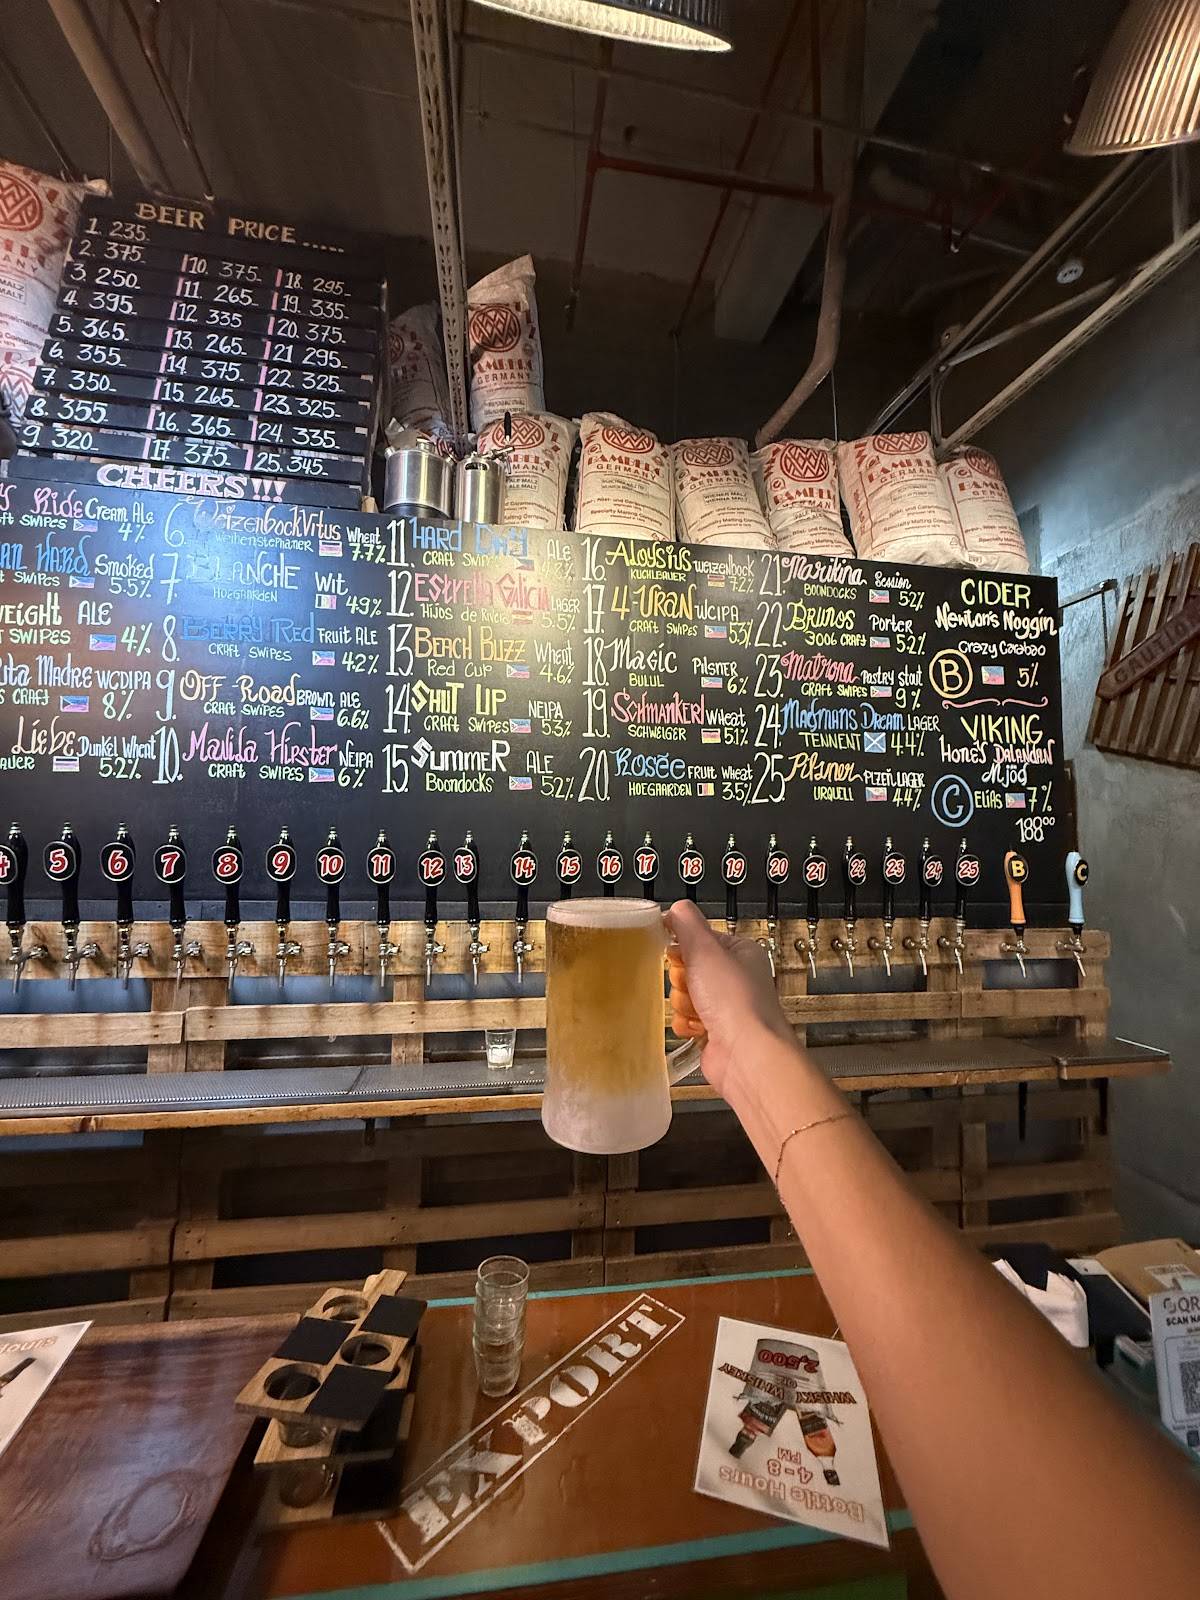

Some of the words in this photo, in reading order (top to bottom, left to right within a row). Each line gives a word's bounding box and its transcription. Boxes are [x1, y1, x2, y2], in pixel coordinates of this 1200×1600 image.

[136, 202, 205, 230] BEER
[205, 309, 243, 328] 335
[478, 372, 530, 384] GERMANY
[597, 464, 656, 480] GERMANY
[315, 572, 349, 595] Wit
[961, 578, 1031, 609] CIDER
[1003, 608, 1058, 640] Noggin
[726, 676, 748, 695] 6%
[938, 658, 963, 693] B
[1017, 662, 1039, 688] 5%
[102, 690, 135, 721] 8%
[476, 684, 507, 716] UP
[529, 700, 564, 719] NEIPA
[895, 687, 921, 711] 9%
[908, 713, 941, 732] LAGER
[960, 714, 1043, 745] VIKING
[798, 732, 861, 751] TENNENT
[526, 751, 554, 774] ALE
[338, 768, 366, 789] 6%
[1026, 781, 1052, 812] 7%
[50, 849, 68, 874] 5
[108, 850, 128, 876] 6
[161, 851, 180, 878] 7
[217, 853, 239, 877] 8
[272, 851, 290, 875] 9
[318, 854, 344, 876] 10
[371, 854, 391, 877] 11
[421, 857, 444, 879] 12
[455, 854, 474, 875] 13
[514, 857, 536, 879] 14
[560, 856, 580, 877] 15
[600, 856, 620, 877] 16
[638, 854, 655, 875] 17
[681, 857, 702, 878] 18
[726, 858, 744, 878] 19
[769, 858, 788, 877] 20
[806, 862, 825, 881] 21
[849, 860, 866, 877] 22
[885, 858, 905, 877] 23
[925, 860, 943, 879] 24
[959, 860, 979, 877] 25
[1011, 860, 1025, 877] B
[1077, 863, 1088, 879] C
[1166, 1314, 1188, 1326] SCAN
[717, 1362, 785, 1400] WHISKEY
[777, 1448, 801, 1465] PM
[719, 1465, 786, 1500] Hours
[791, 1485, 864, 1522] Bottle
